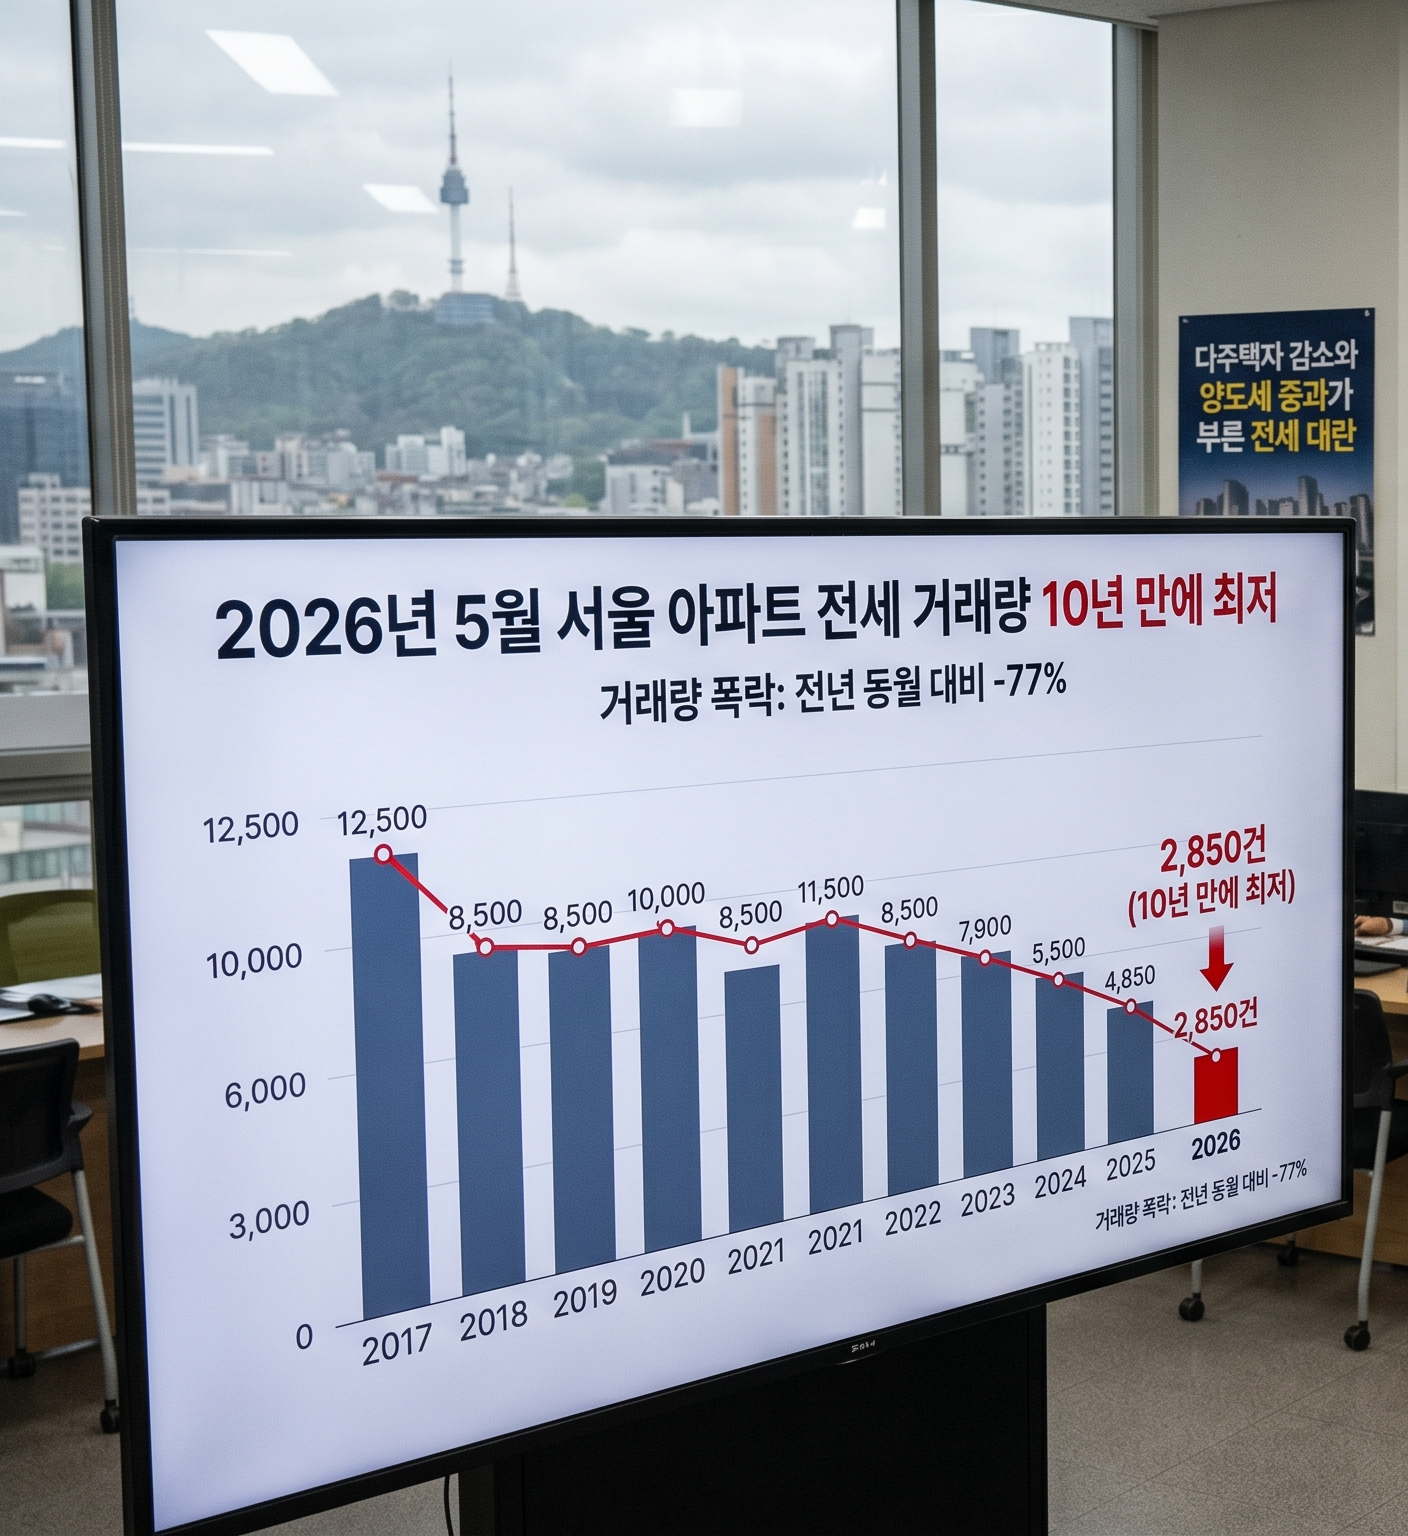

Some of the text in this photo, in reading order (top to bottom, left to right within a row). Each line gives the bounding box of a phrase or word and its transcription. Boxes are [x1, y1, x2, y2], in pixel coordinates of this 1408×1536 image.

[1195, 339, 1358, 373] 다주택자 감소와
[1200, 378, 1353, 413] 양도세 중과가
[1196, 418, 1357, 453] 부른 전세 대란
[216, 571, 1276, 659] 2026년 5월 서울 아파트 전세 거래량 10년 만에 최저
[601, 662, 1066, 725] 거래량 폭락: 전년 동월 대비 -77%
[204, 811, 298, 846] 12,500
[338, 805, 427, 838] 12,500
[1160, 824, 1265, 877] 2,850건
[628, 882, 705, 914] 10,000
[798, 875, 864, 905] 11,500
[1129, 869, 1295, 928] (10년 만에 최저)
[449, 900, 521, 932] 8,500
[544, 900, 612, 933] 8,500
[720, 900, 782, 932] 8,500
[882, 896, 938, 926] 8,500
[959, 915, 1011, 945] 7,900
[207, 943, 302, 980] 10,000
[1033, 937, 1085, 966] 5,500
[1105, 965, 1155, 994] 4,850
[1174, 996, 1258, 1043] 2,850건
[226, 1072, 305, 1112] 6,000
[1096, 1159, 1307, 1231] 거래량 폭락: 전년 동월 대비 -77%
[230, 1201, 309, 1241] 3,000
[363, 1129, 1240, 1366] 2017 2018 2019 2020 2021 2021 2022 2023 2024 2025 2026
[296, 1324, 312, 1349] 0
